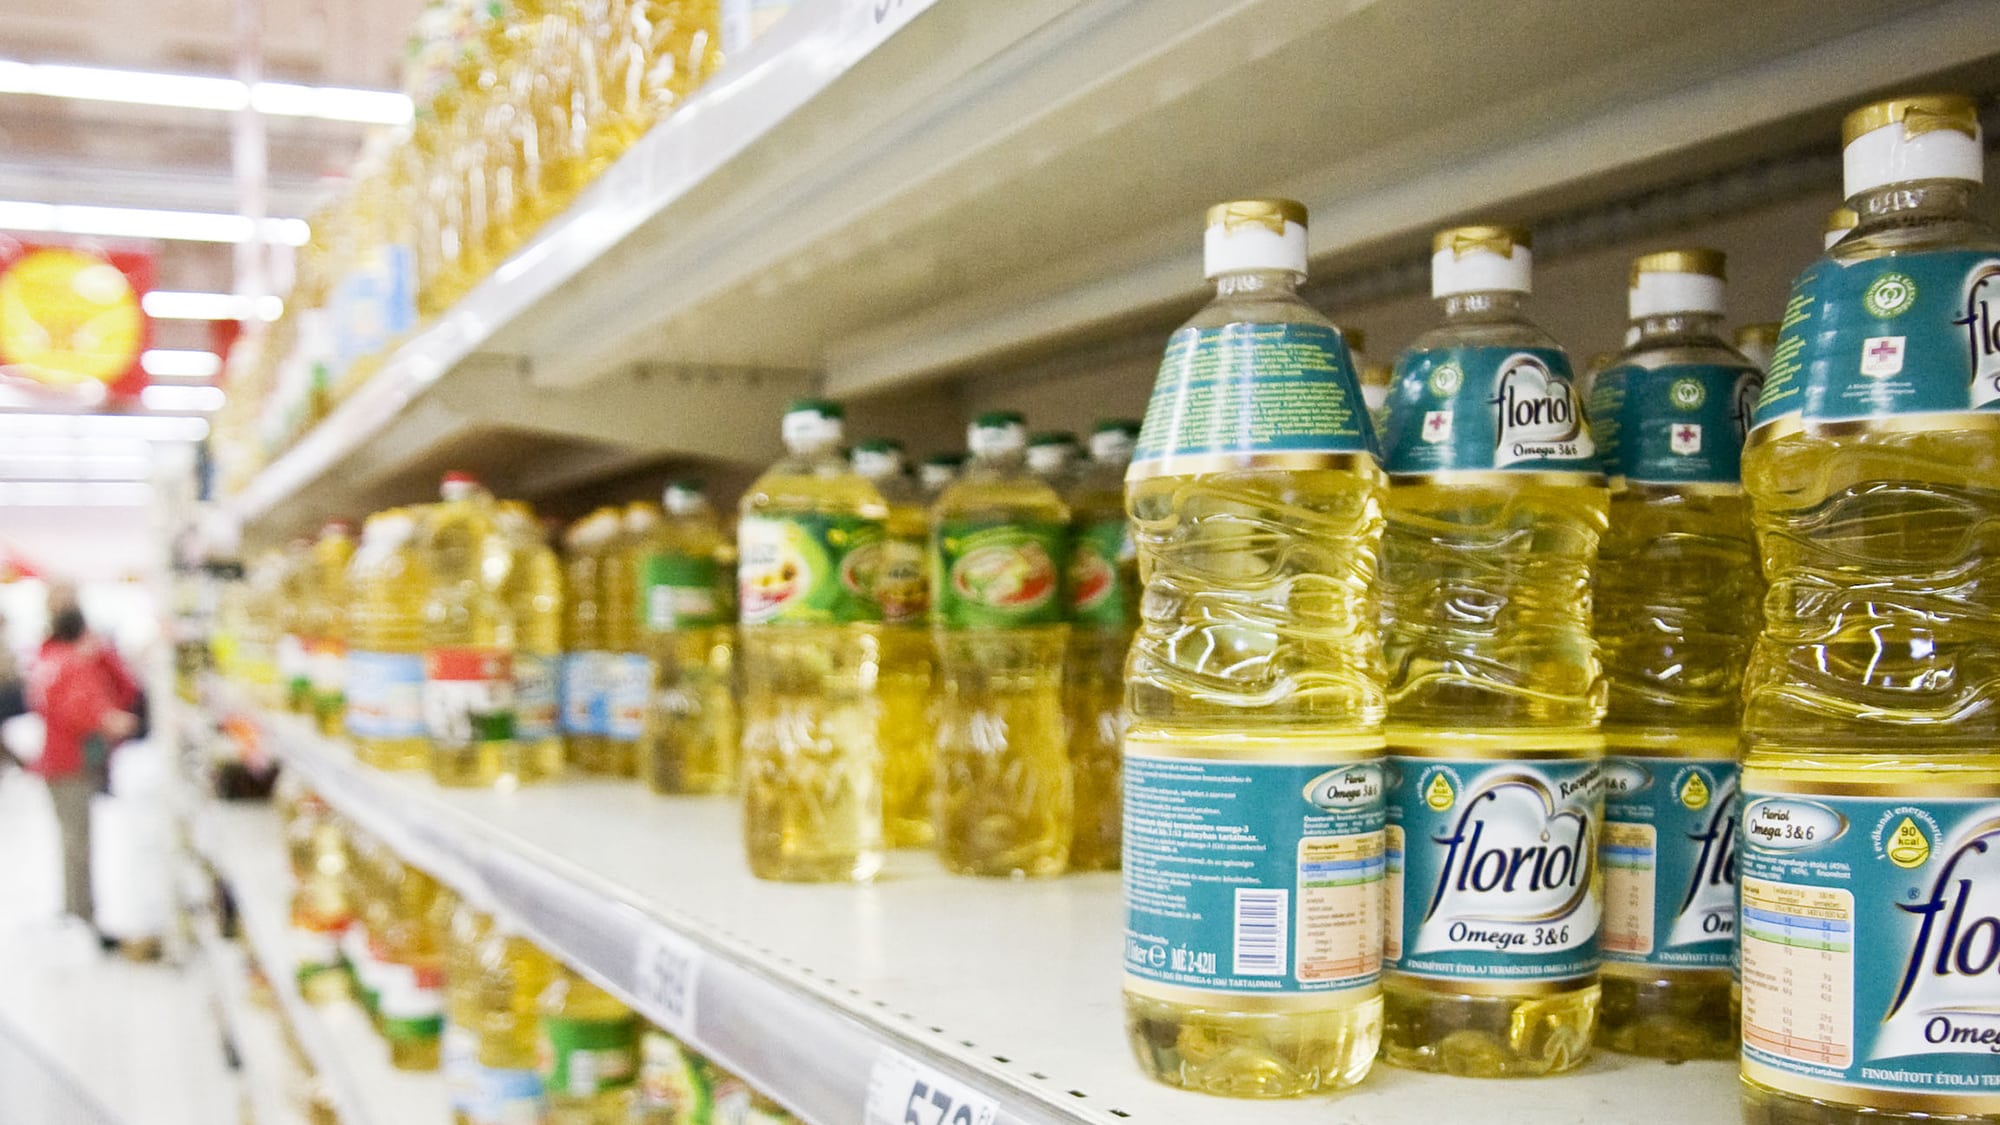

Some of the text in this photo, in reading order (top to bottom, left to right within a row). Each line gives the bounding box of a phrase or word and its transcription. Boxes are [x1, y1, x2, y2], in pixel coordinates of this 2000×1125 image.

[1487, 369, 1573, 450] floriol
[1513, 444, 1555, 457] Omega
[1327, 786, 1361, 801] Omega
[1762, 806, 1790, 821] Floriol
[1751, 819, 1782, 841] Omega
[1901, 826, 1917, 836] 90
[1898, 838, 1920, 846] kcal
[1424, 791, 1587, 924] floriol
[1449, 922, 1569, 949] Omega 3&6
[1861, 1067, 1934, 1084] FINOMÍTOTT
[1936, 1071, 1980, 1086] ÉTOLAJ
